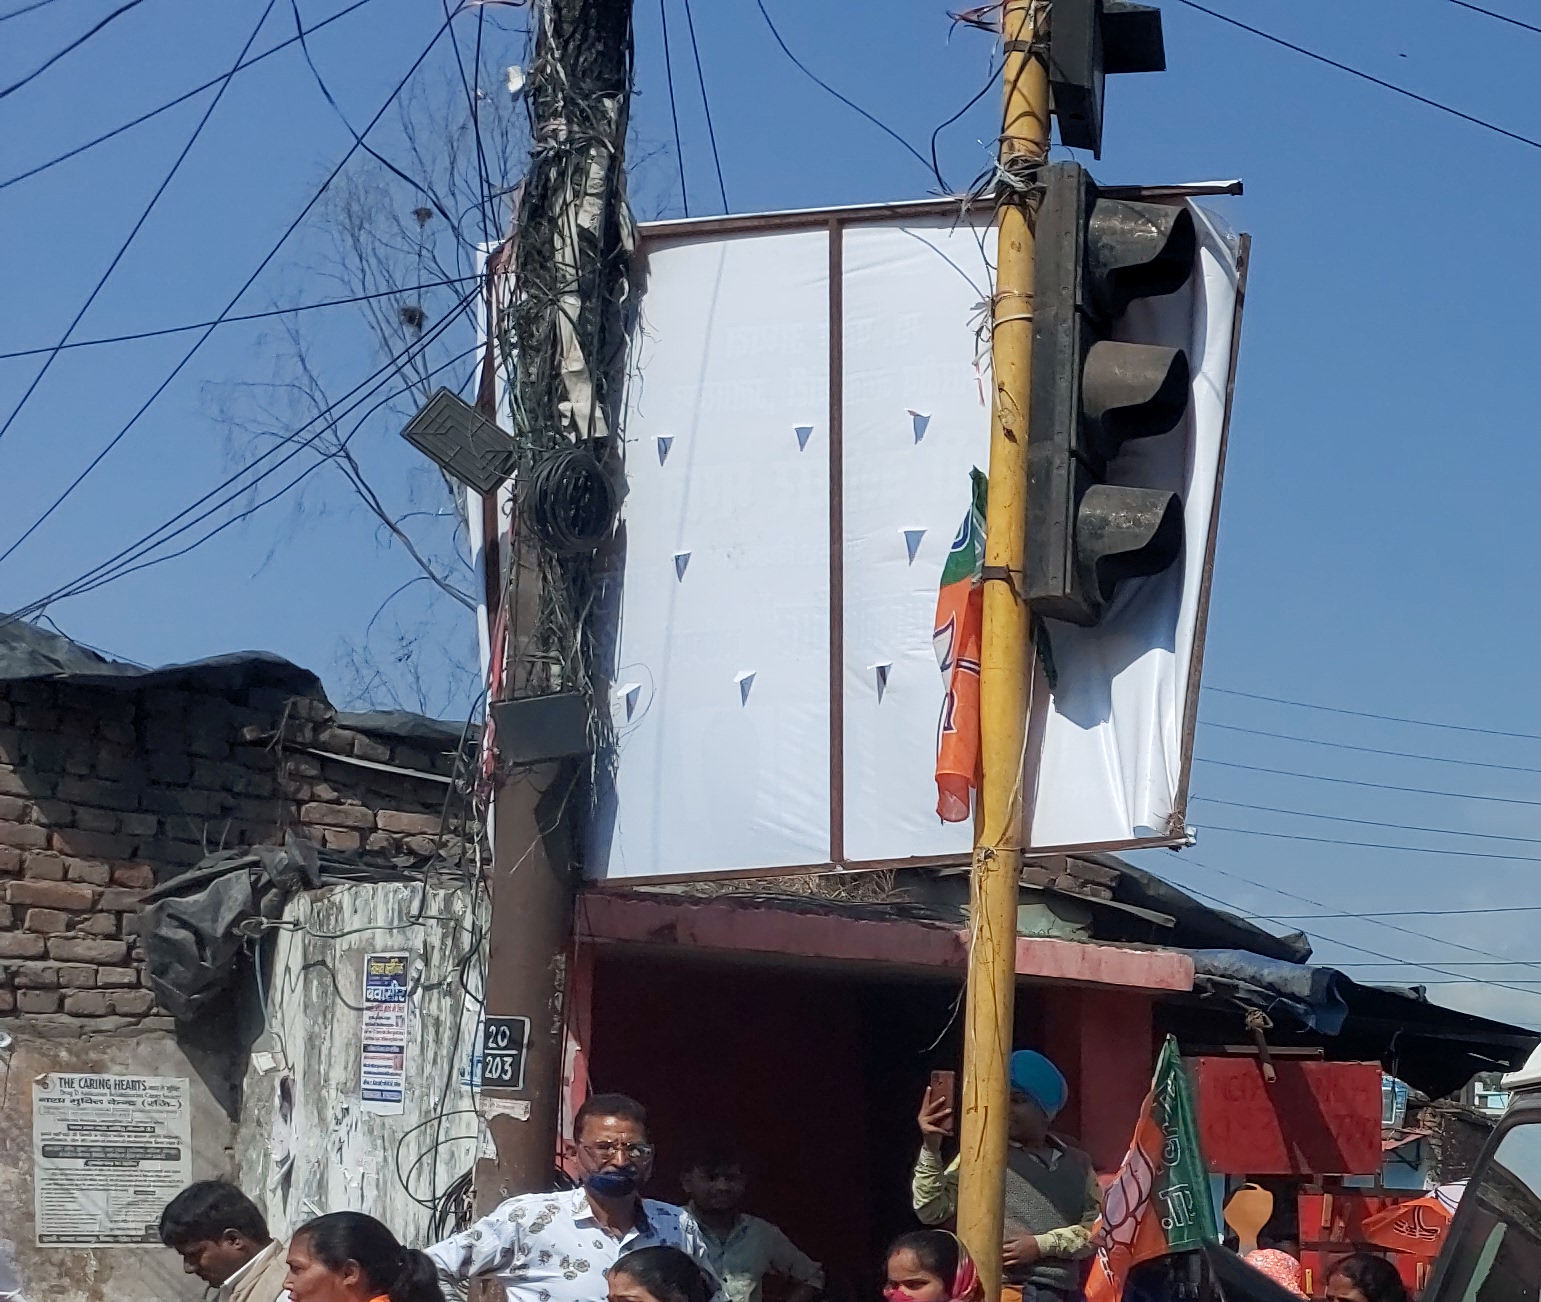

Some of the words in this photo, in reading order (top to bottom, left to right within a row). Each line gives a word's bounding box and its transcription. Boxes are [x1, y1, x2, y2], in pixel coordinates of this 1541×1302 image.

[488, 1025, 510, 1048] 20
[484, 1055, 514, 1081] 203
[58, 1077, 75, 1089] THE
[78, 1078, 112, 1091] CARING
[114, 1079, 147, 1092] HEARTS
